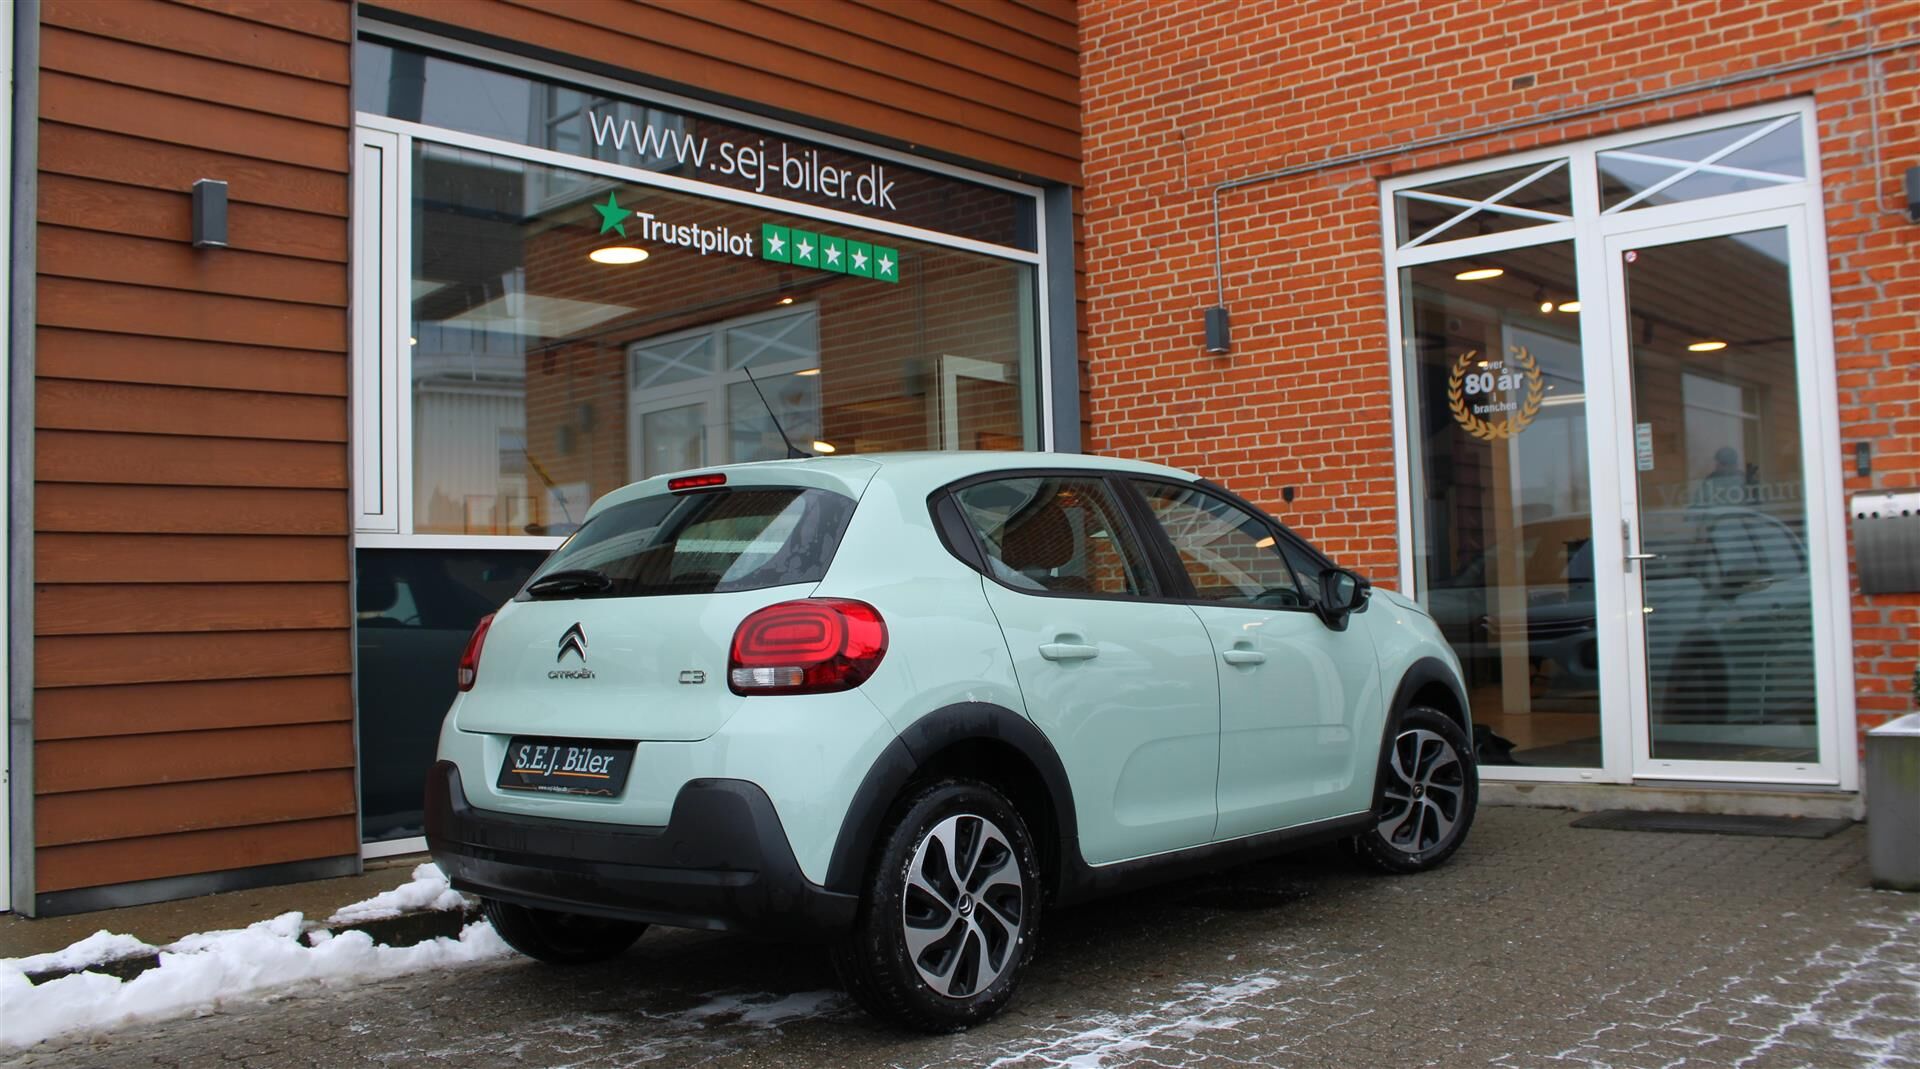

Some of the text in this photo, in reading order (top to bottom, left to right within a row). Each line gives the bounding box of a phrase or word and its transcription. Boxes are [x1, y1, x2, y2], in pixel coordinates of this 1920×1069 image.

[588, 110, 897, 210] www.sej-biler.dk
[636, 211, 754, 258] Trustpilot
[1465, 368, 1523, 394] 80 år
[1473, 402, 1518, 414] branchen
[678, 669, 707, 685] C3
[515, 744, 614, 776] S.E.J. Biler
